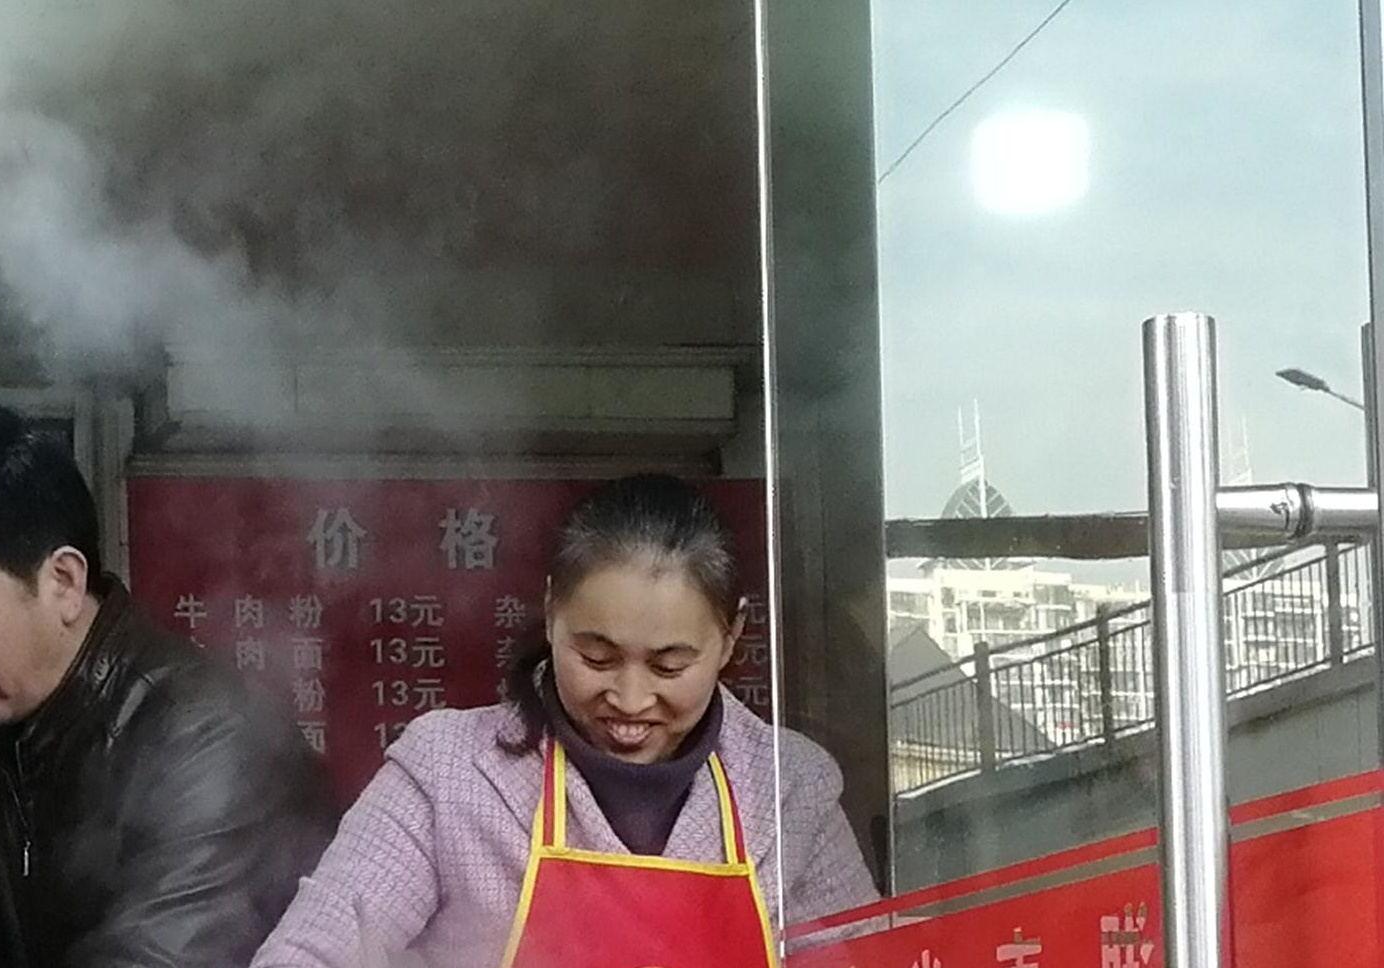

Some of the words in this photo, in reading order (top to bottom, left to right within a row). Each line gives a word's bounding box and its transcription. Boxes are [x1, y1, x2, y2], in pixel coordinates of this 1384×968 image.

[306, 506, 500, 570] 价格
[174, 595, 323, 629] 牛肉粉
[369, 595, 445, 628] 13元
[370, 637, 446, 668] 13元
[372, 678, 446, 709] 13元
